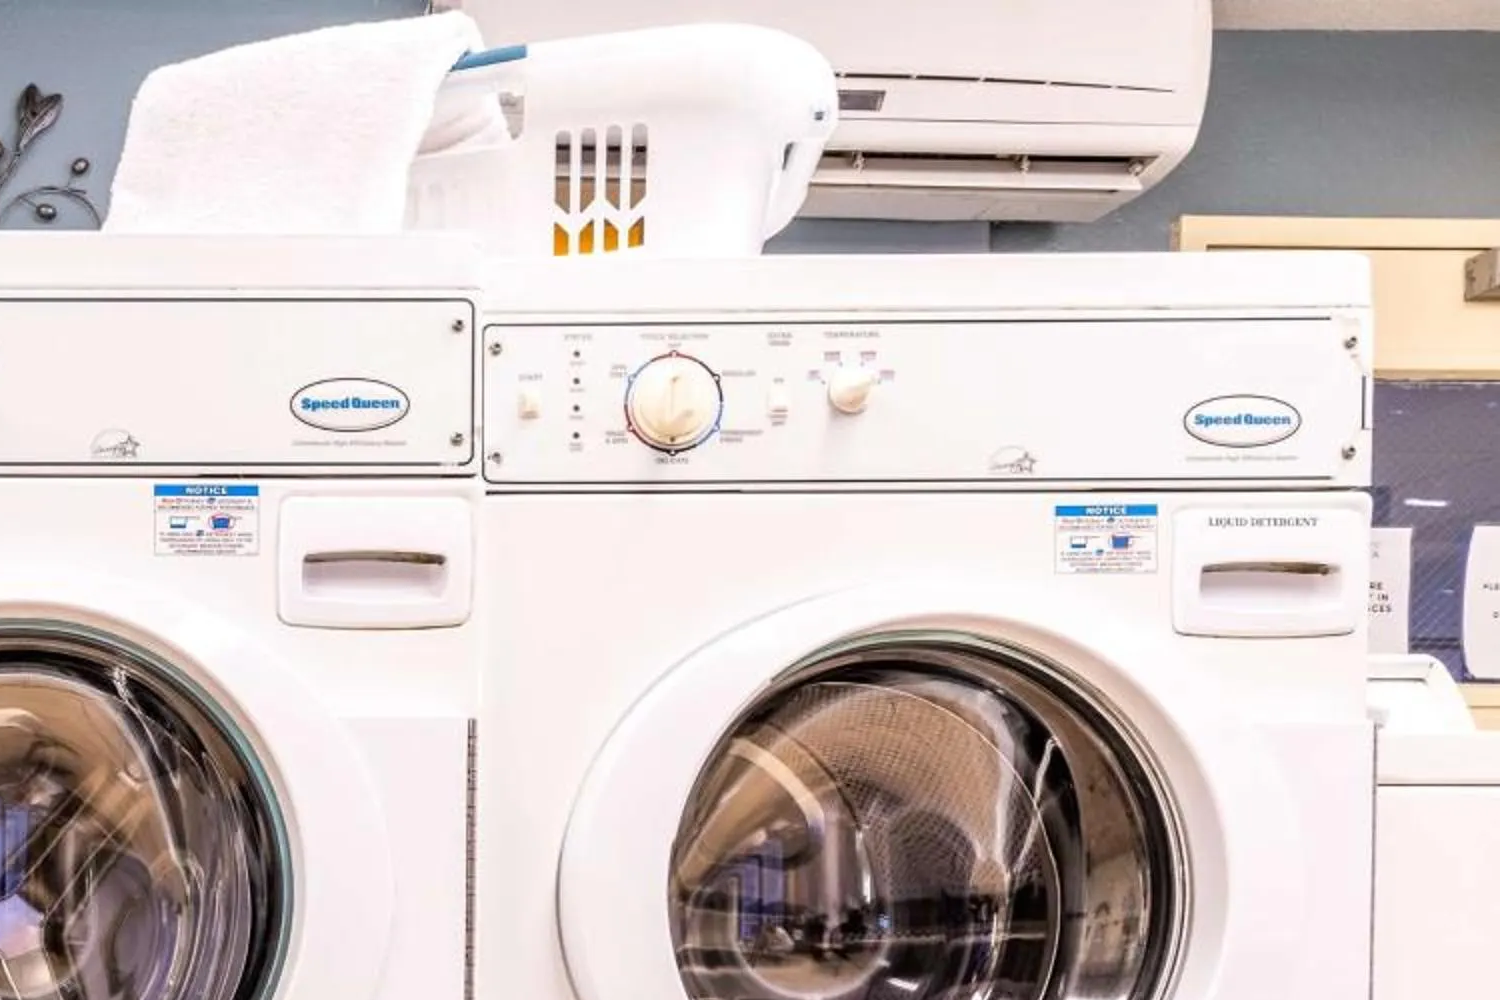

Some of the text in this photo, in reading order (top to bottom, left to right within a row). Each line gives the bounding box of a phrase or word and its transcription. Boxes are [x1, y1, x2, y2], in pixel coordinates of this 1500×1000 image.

[301, 397, 400, 412] Speed Queen
[1194, 413, 1292, 428] Speed Queen
[184, 487, 228, 496] NOTICE
[1085, 506, 1128, 516] NOTICE
[1208, 516, 1318, 529] LIQUID DETERGENT
